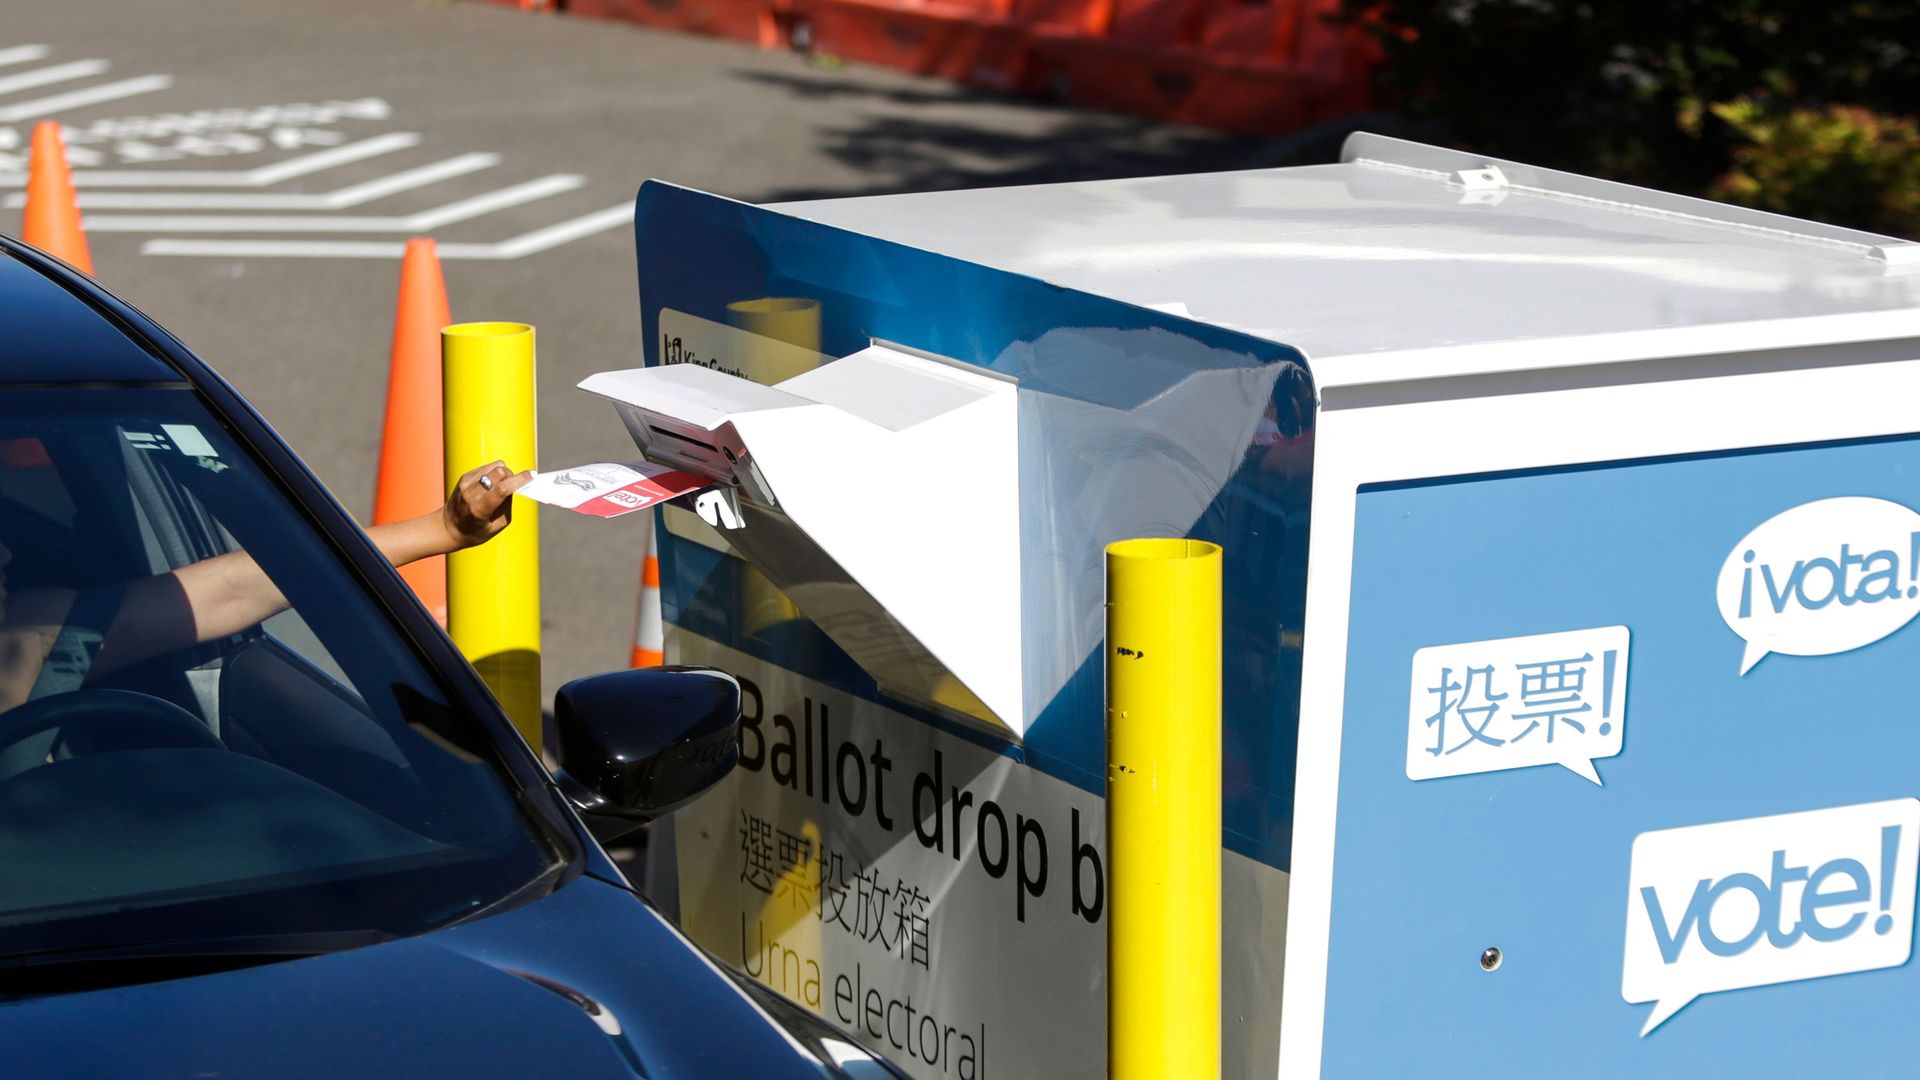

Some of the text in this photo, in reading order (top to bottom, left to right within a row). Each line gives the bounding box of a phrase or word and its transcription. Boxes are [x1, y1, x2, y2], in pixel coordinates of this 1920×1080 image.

[1738, 531, 1920, 618] ¡vota!
[737, 675, 893, 832] Ballot
[912, 750, 1049, 922] drop
[739, 809, 930, 971] 選票投放箱
[1640, 824, 1902, 965] vote!
[742, 912, 985, 1080] Urna electoral
